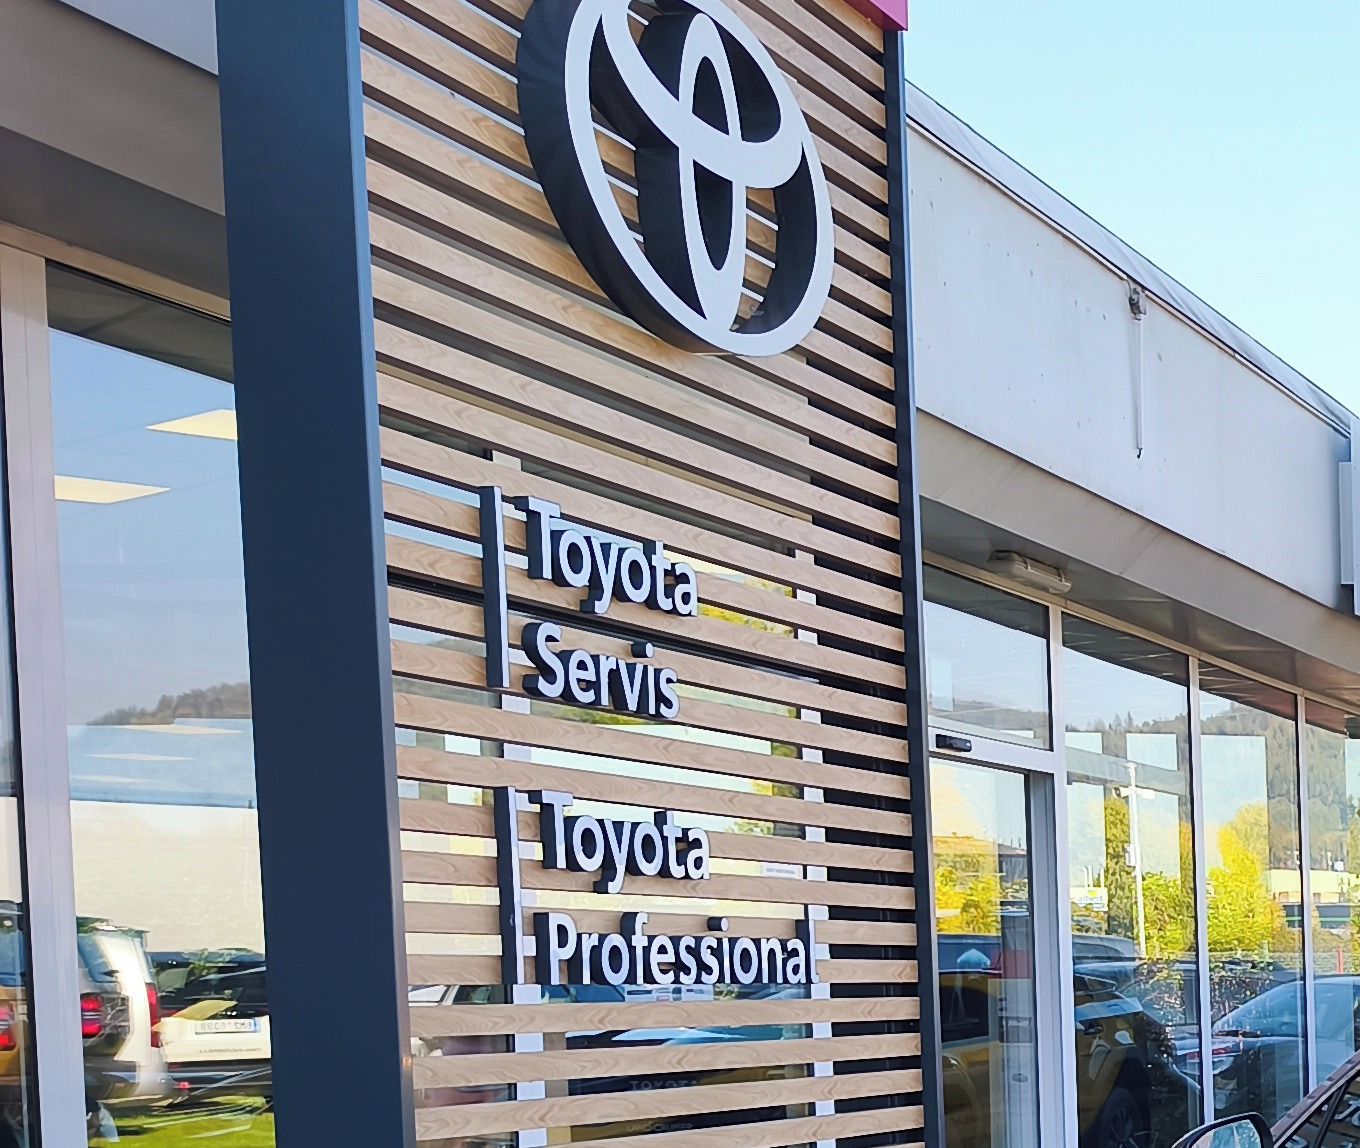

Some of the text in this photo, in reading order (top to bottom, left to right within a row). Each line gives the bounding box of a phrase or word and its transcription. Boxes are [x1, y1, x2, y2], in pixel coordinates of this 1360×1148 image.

[526, 495, 698, 617] Toyota
[534, 621, 681, 719] Servis
[541, 788, 711, 894] Toyota
[547, 911, 821, 986] Professional
